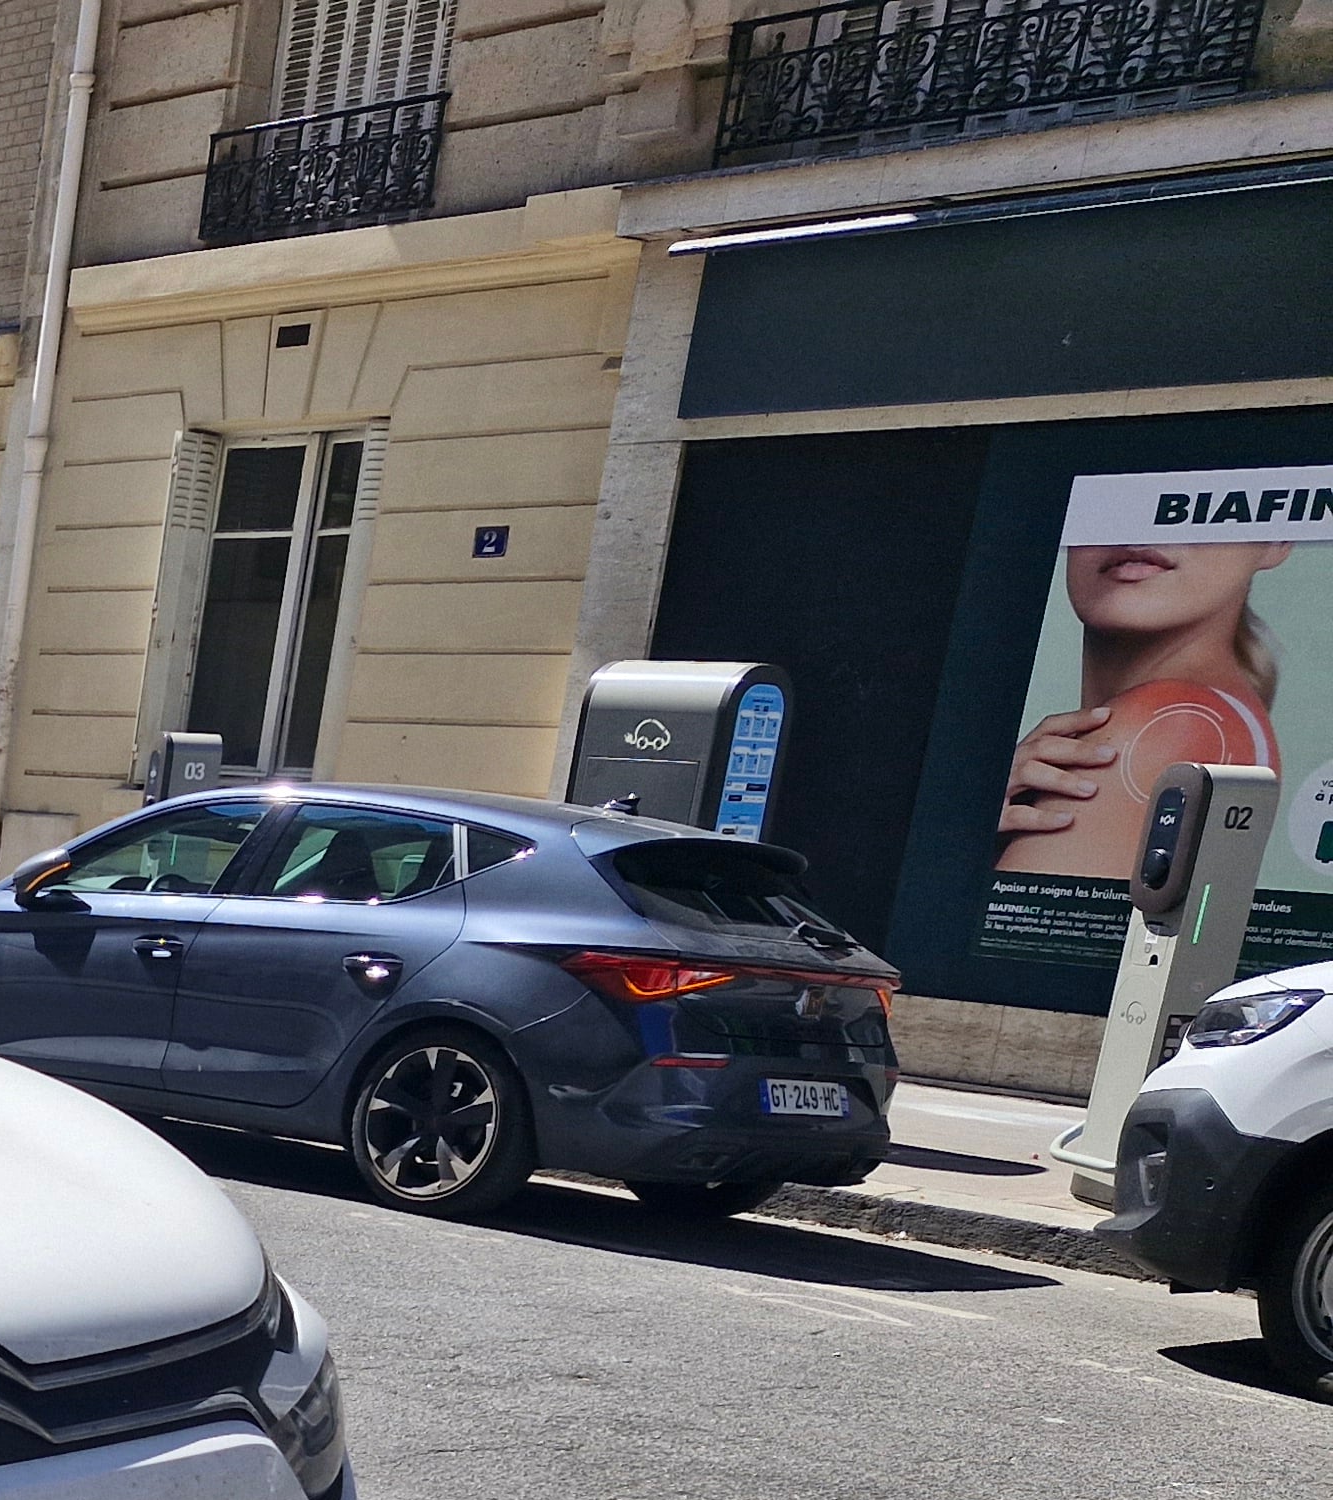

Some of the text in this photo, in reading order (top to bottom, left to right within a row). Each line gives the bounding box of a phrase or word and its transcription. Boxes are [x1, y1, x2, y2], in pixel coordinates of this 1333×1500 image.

[482, 530, 497, 553] 2
[184, 762, 206, 780] 03
[1314, 789, 1325, 801] à
[1224, 806, 1254, 830] 02
[992, 880, 1027, 894] Apaise
[1029, 885, 1039, 894] et
[1040, 885, 1074, 899] soigne
[1075, 886, 1090, 898] les
[1251, 899, 1293, 914] endues
[988, 902, 1042, 915] BIAFINEACT
[1040, 916, 1052, 925] de
[771, 1084, 840, 1112] GT-249-HC
